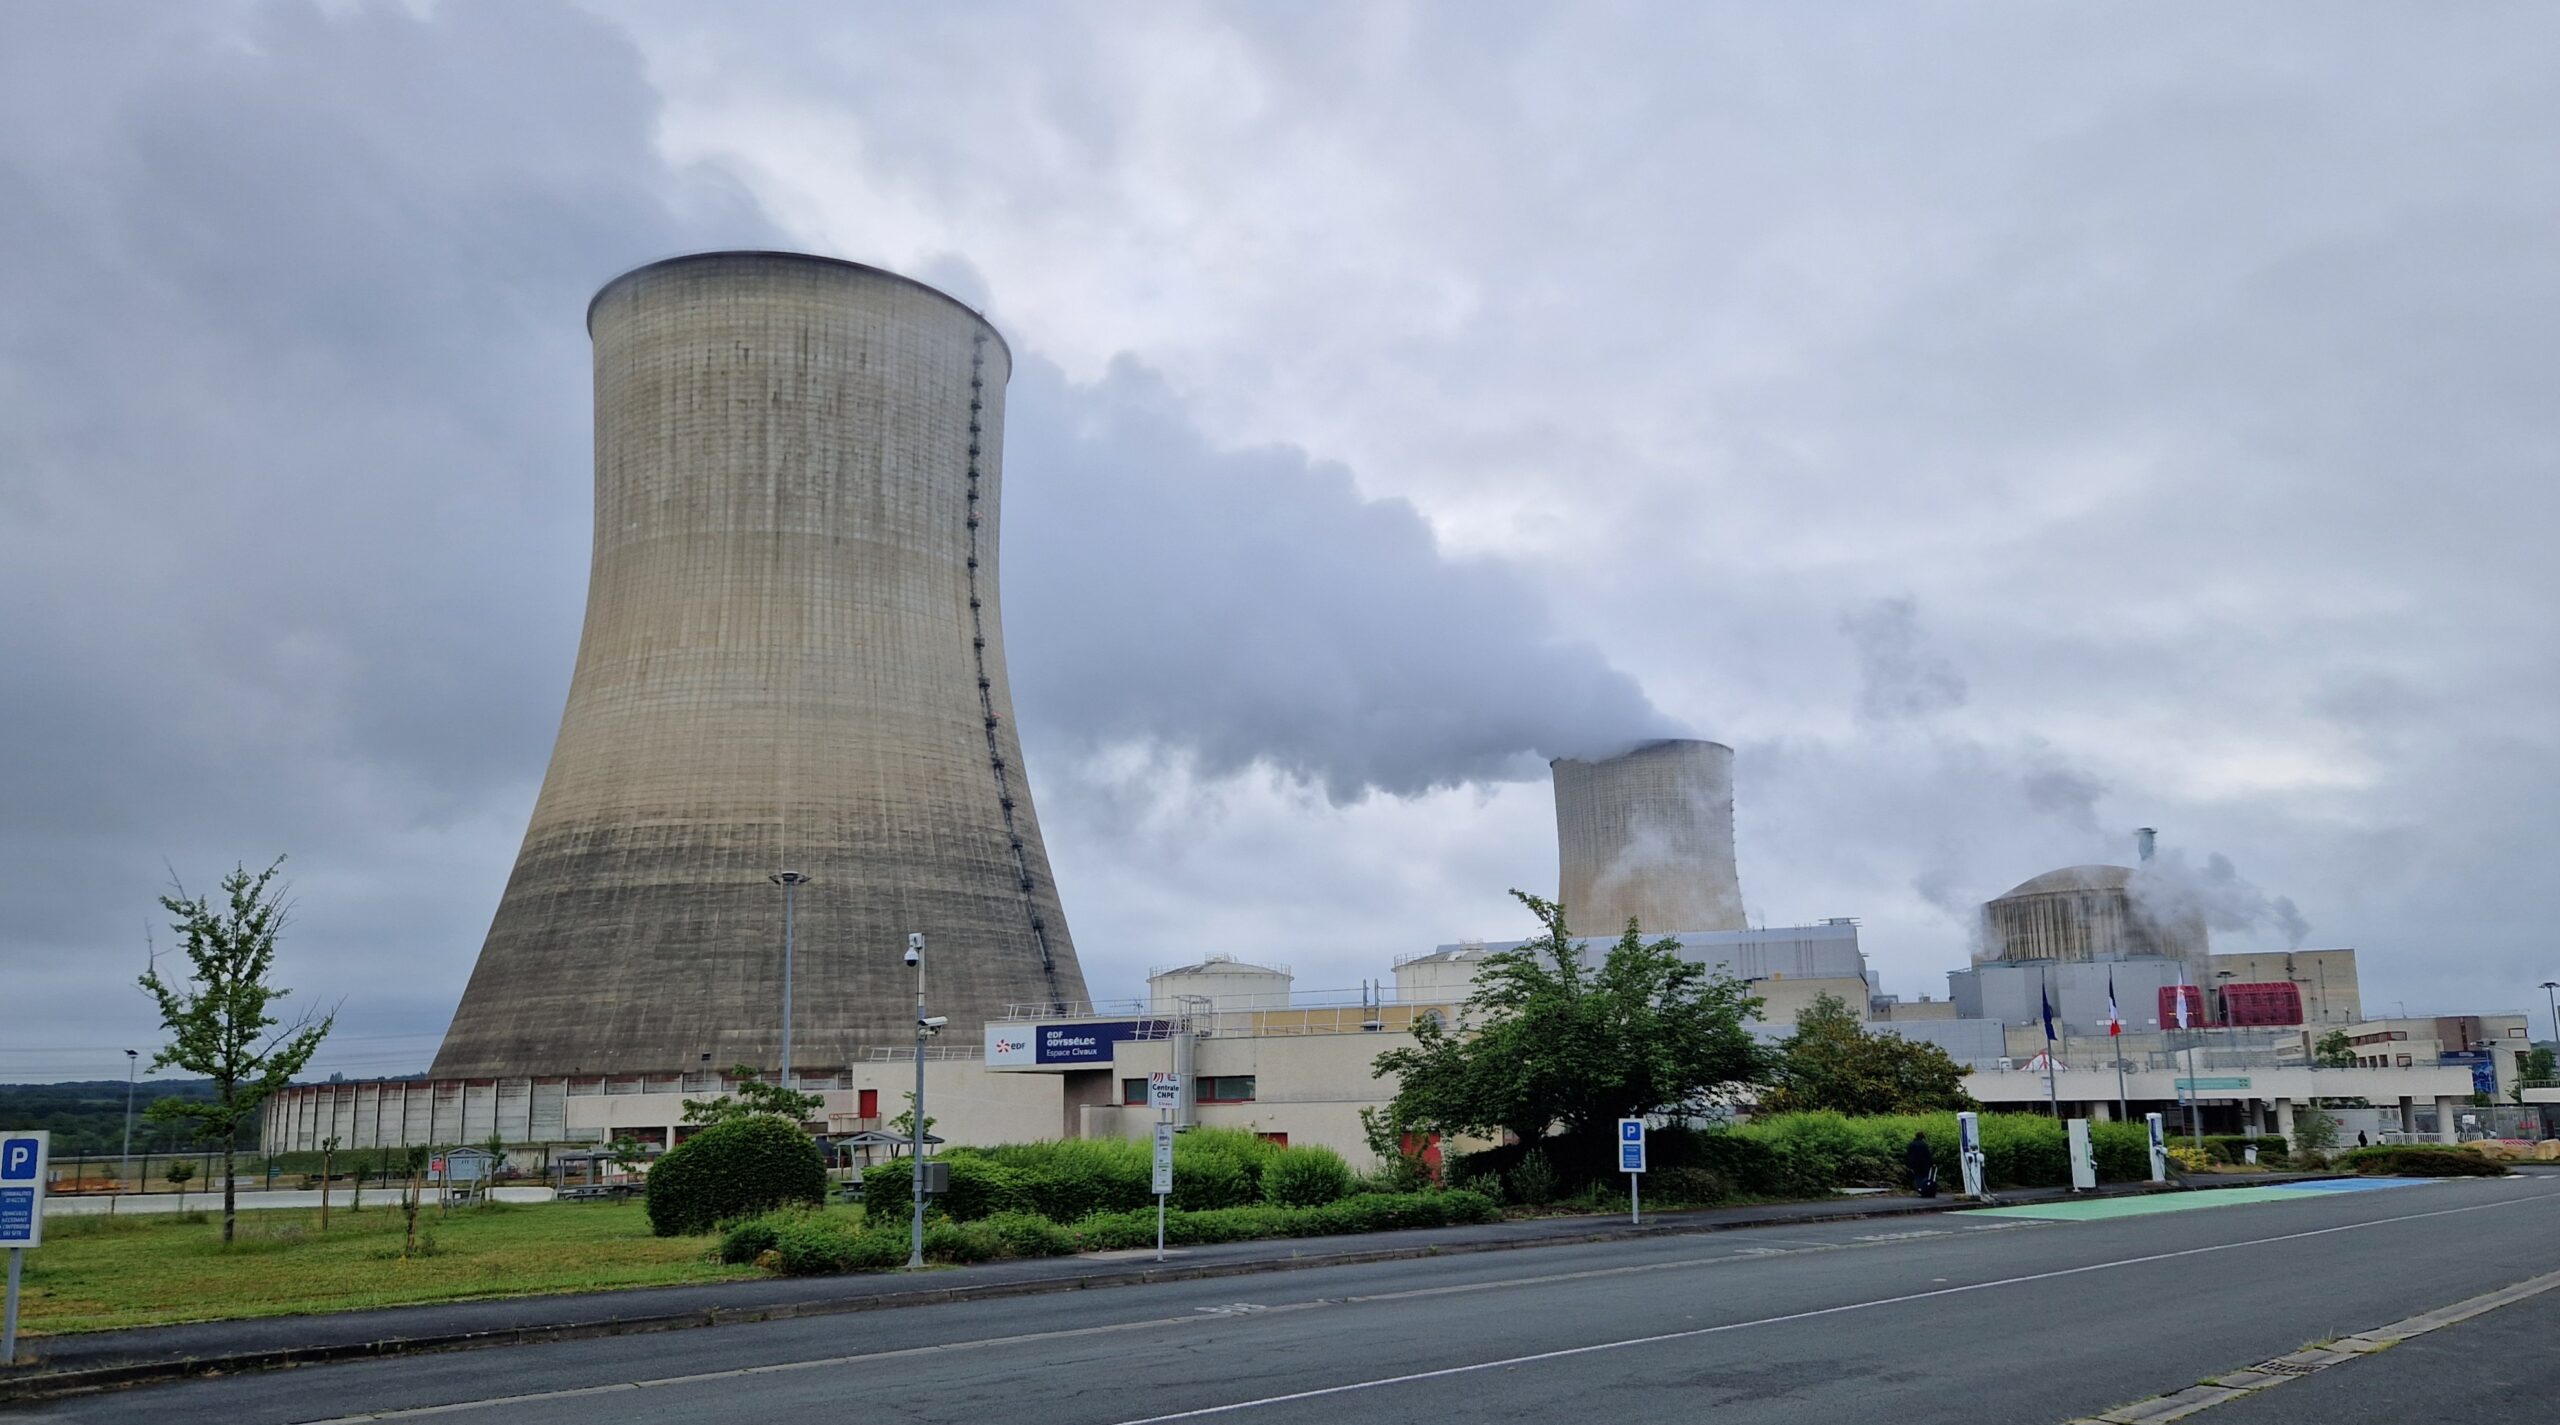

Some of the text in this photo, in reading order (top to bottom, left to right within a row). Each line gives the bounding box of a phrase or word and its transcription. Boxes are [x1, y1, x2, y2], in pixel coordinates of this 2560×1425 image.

[1046, 1049, 1070, 1058] Espace
[1627, 1126, 1636, 1138] P
[11, 1147, 28, 1171] P
